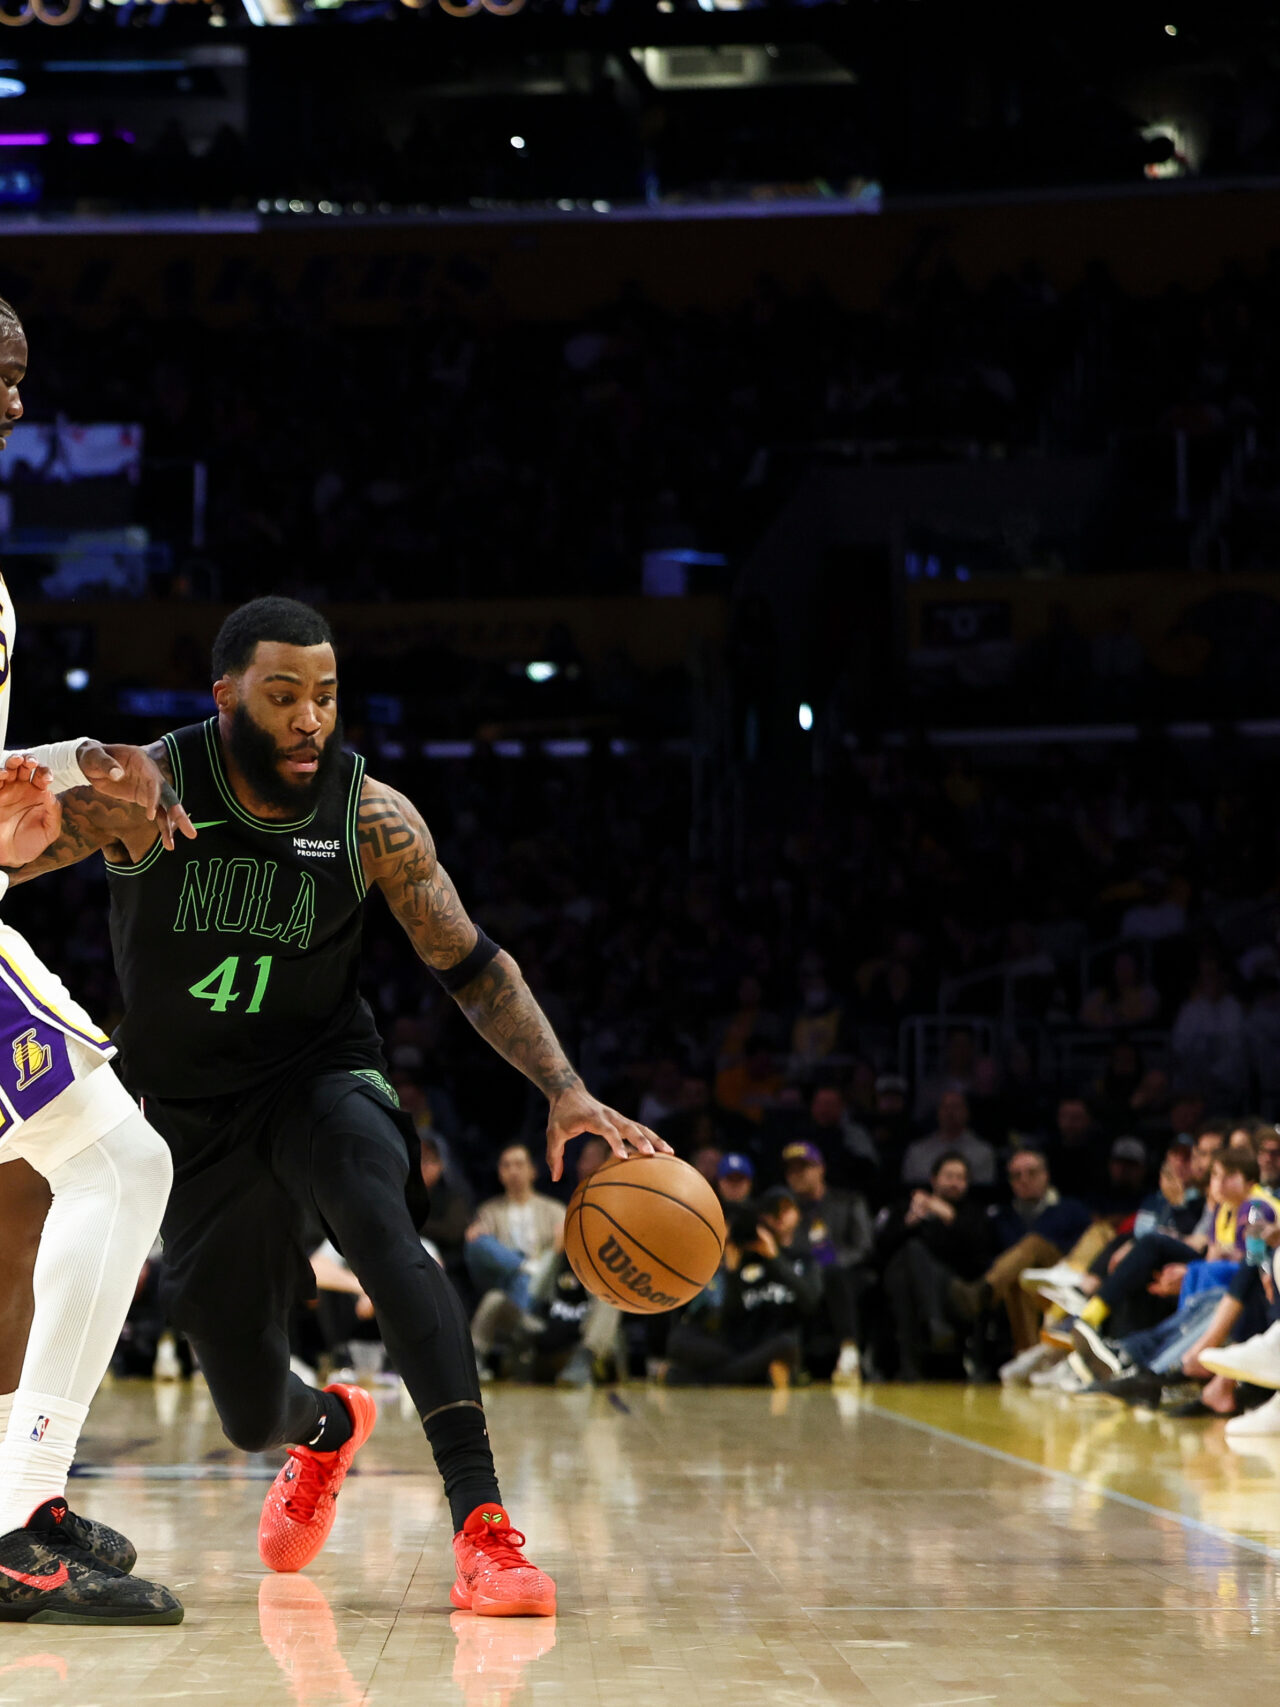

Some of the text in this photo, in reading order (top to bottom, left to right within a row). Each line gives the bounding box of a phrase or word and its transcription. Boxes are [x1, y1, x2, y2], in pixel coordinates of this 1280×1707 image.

[293, 837, 341, 850] NEWAGE
[297, 849, 336, 858] PRODUCTS
[173, 857, 316, 949] NOLA
[188, 955, 273, 1013] 41
[598, 1234, 681, 1307] Wilson
